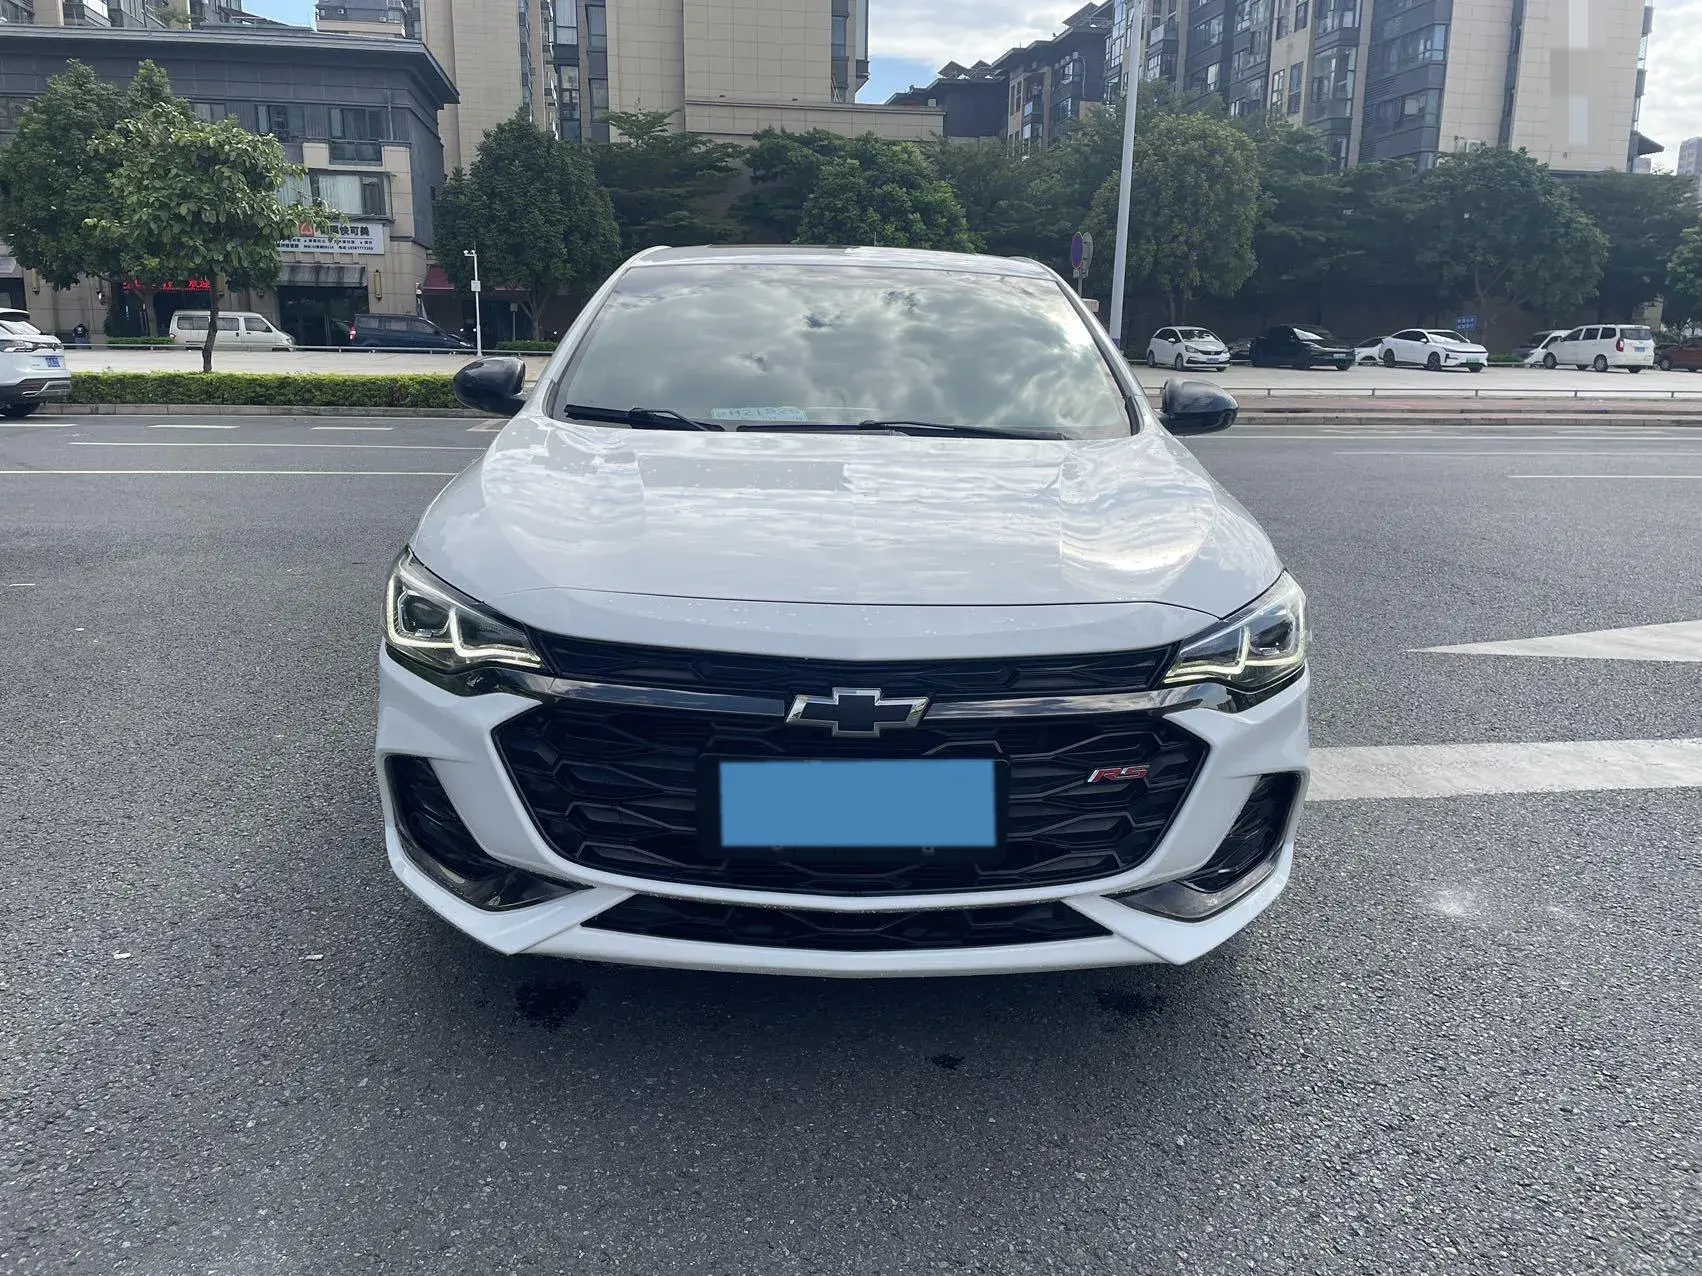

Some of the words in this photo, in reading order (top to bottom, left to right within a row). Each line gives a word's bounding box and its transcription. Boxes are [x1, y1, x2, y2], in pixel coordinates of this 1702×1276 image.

[321, 225, 370, 236] 快可美
[1087, 765, 1149, 782] RS
